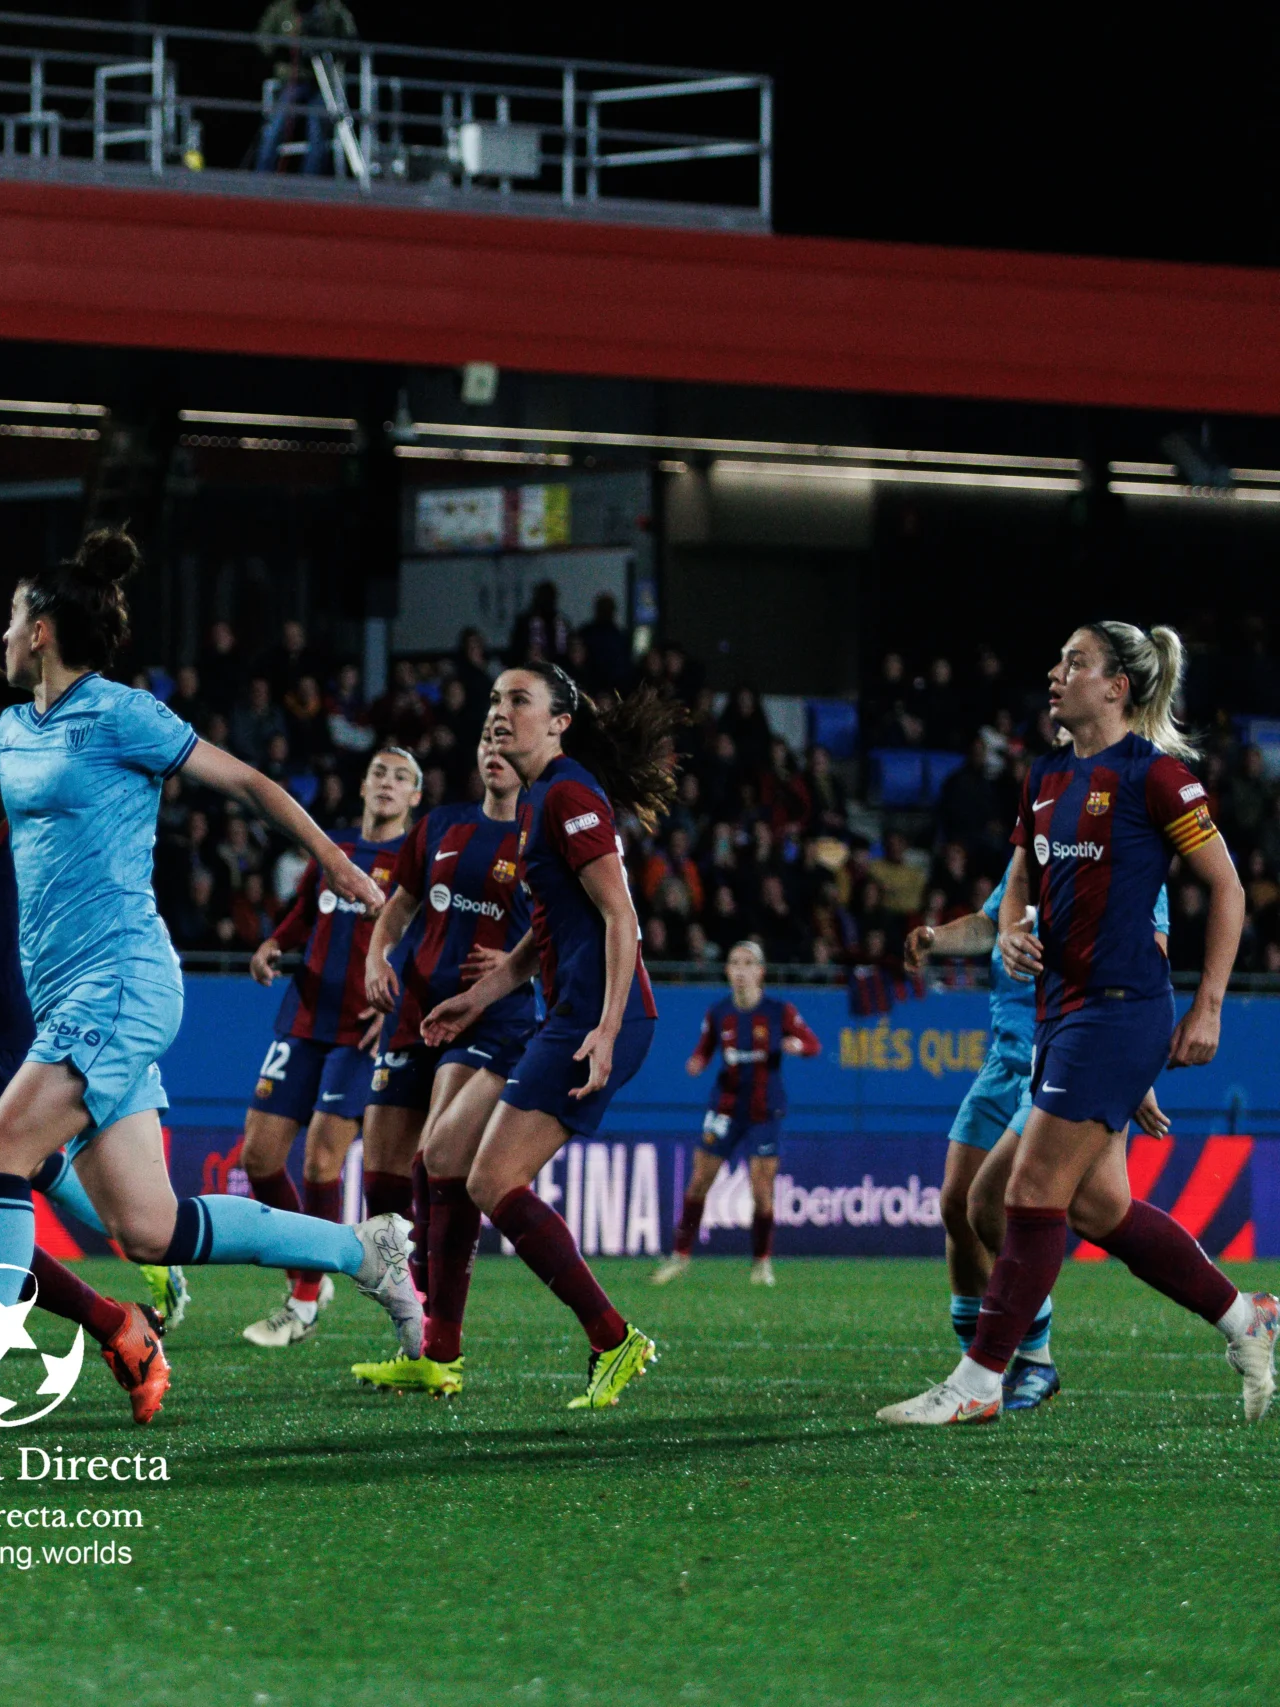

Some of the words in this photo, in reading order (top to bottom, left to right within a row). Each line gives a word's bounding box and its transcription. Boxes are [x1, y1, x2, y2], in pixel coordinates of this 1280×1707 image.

[565, 813, 600, 835] BIMBO
[1052, 841, 1104, 861] Spotify
[452, 893, 505, 921] Spotify
[260, 1040, 292, 1081] 12
[840, 1017, 913, 1071] MÉS
[919, 1028, 988, 1079] QUE
